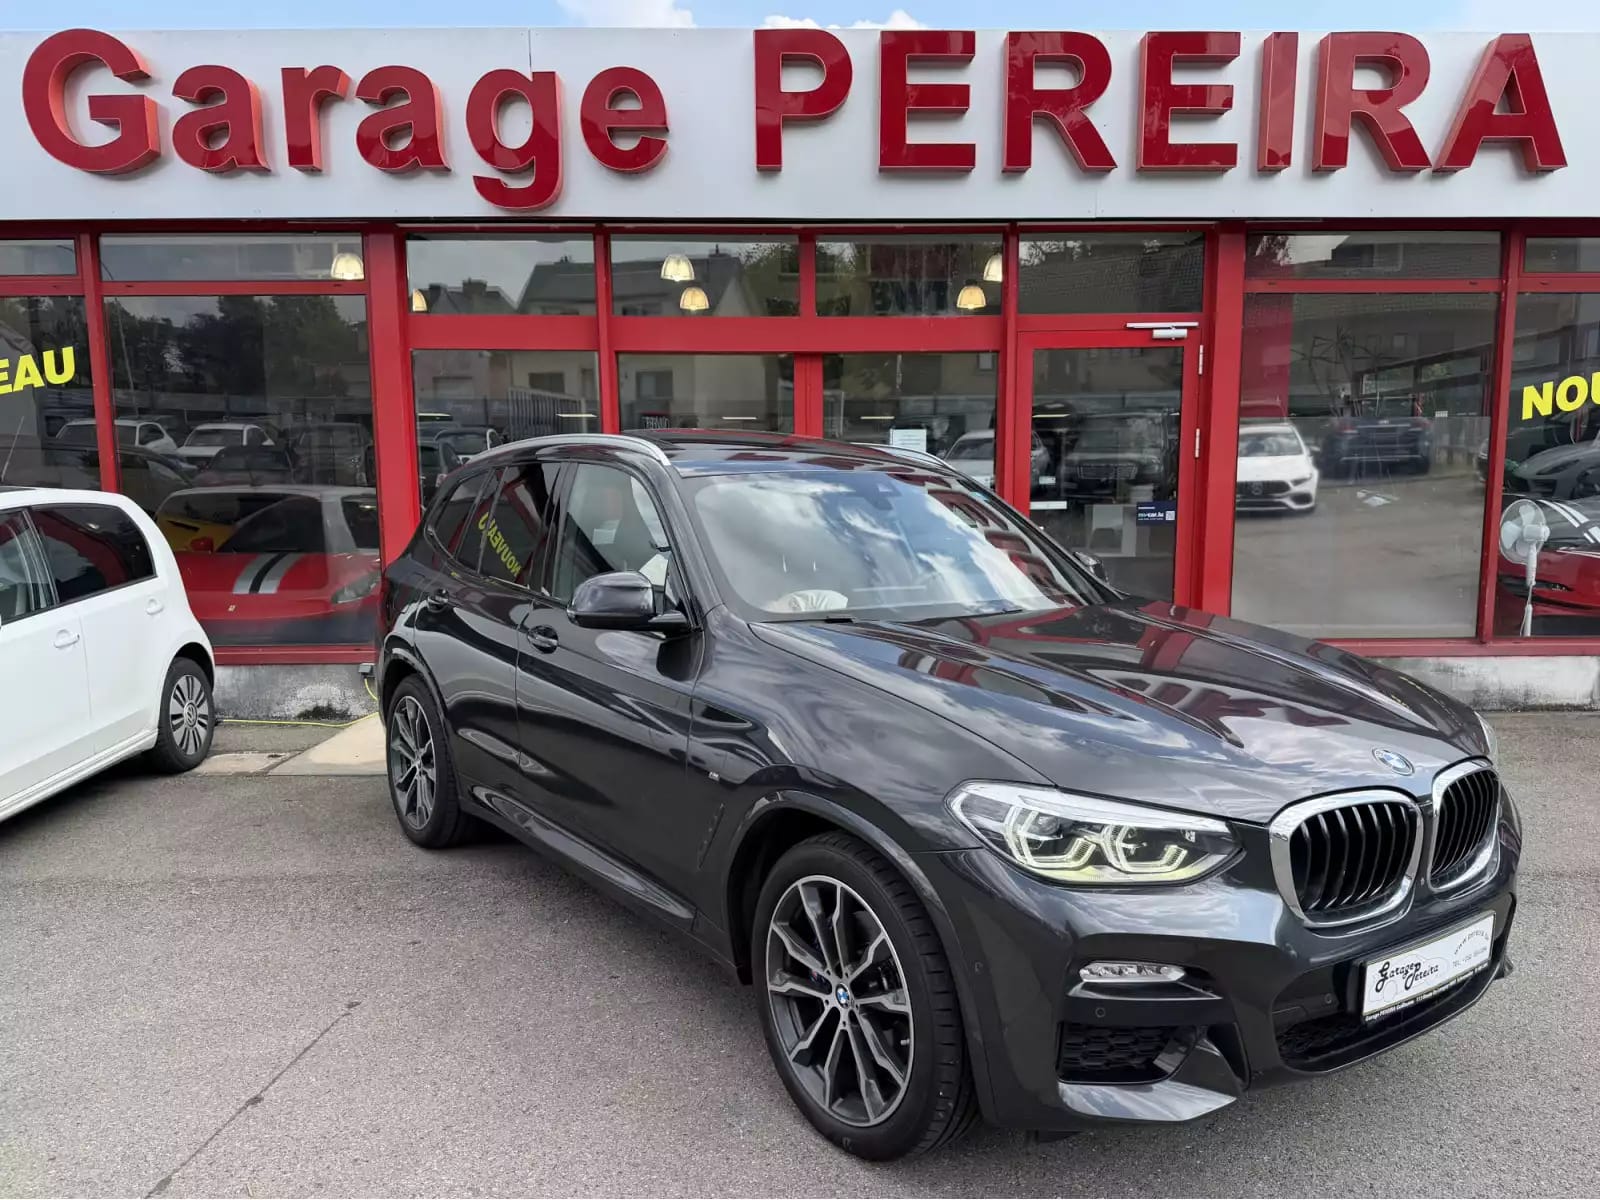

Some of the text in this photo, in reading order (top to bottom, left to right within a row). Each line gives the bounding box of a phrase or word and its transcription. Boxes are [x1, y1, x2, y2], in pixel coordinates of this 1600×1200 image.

[22, 28, 1568, 211] Garage PEREIRA
[1521, 371, 1600, 420] NO
